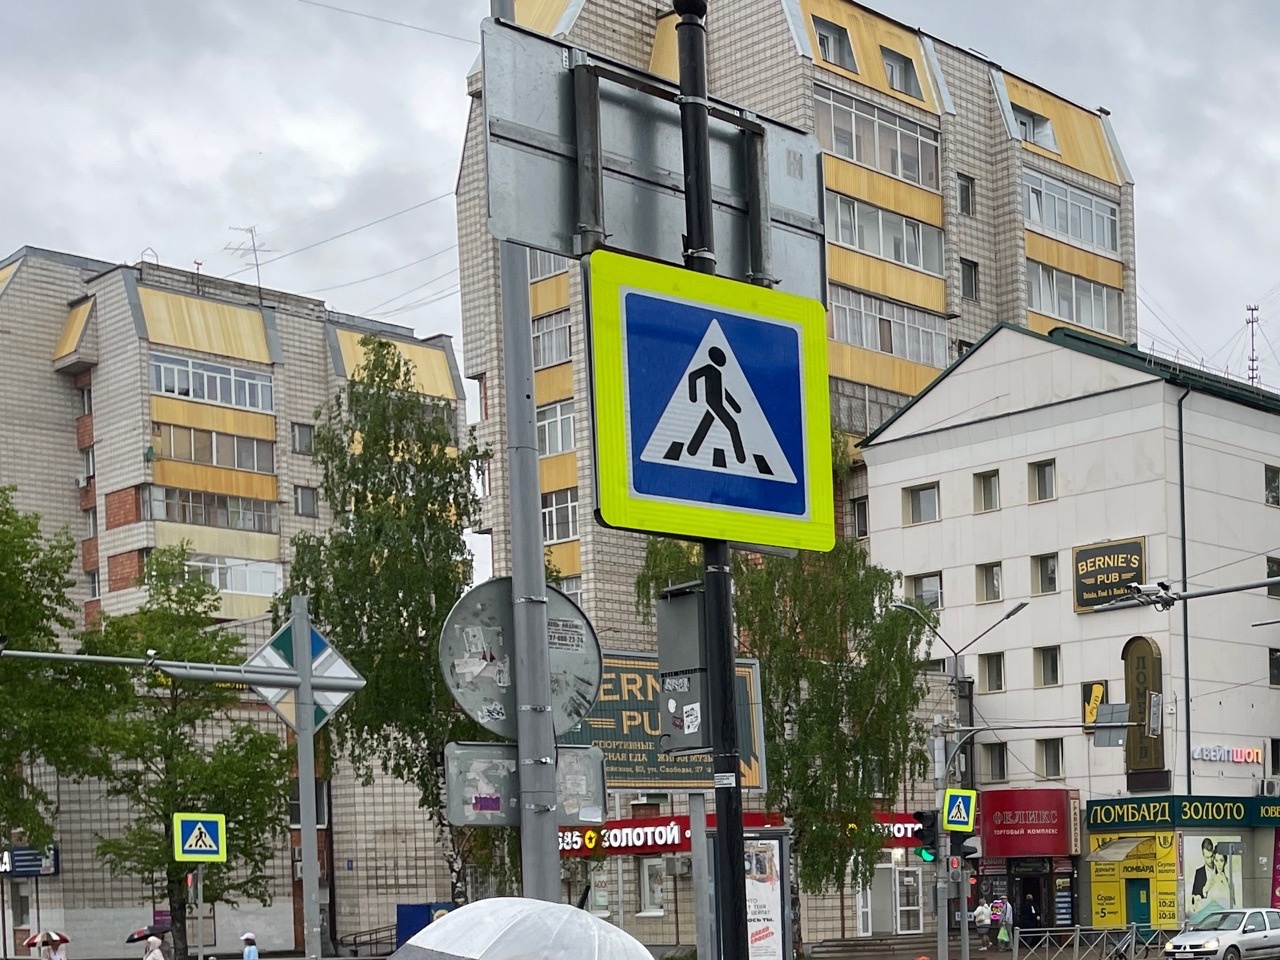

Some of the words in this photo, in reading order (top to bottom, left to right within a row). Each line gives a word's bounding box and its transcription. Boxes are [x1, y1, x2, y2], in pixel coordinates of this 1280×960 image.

[1077, 553, 1140, 575] BERNIE'S
[1097, 572, 1120, 585] PUB
[1089, 694, 1100, 717] PUB
[591, 740, 655, 750] СПОРТИВНЫЕ
[629, 753, 648, 762] ЕДА
[992, 810, 1058, 825] ФЕЛИКС
[1090, 802, 1171, 823] ЛОМБАРД
[1181, 801, 1245, 820] ЗОЛОТО
[600, 820, 682, 848] ЗОЛОТОЙ
[993, 827, 1025, 835] ТОРГОВЫЙ
[978, 857, 1006, 866] РЕМОНТ
[1122, 866, 1155, 874] ЛОМБАРД
[1099, 908, 1106, 918] 5
